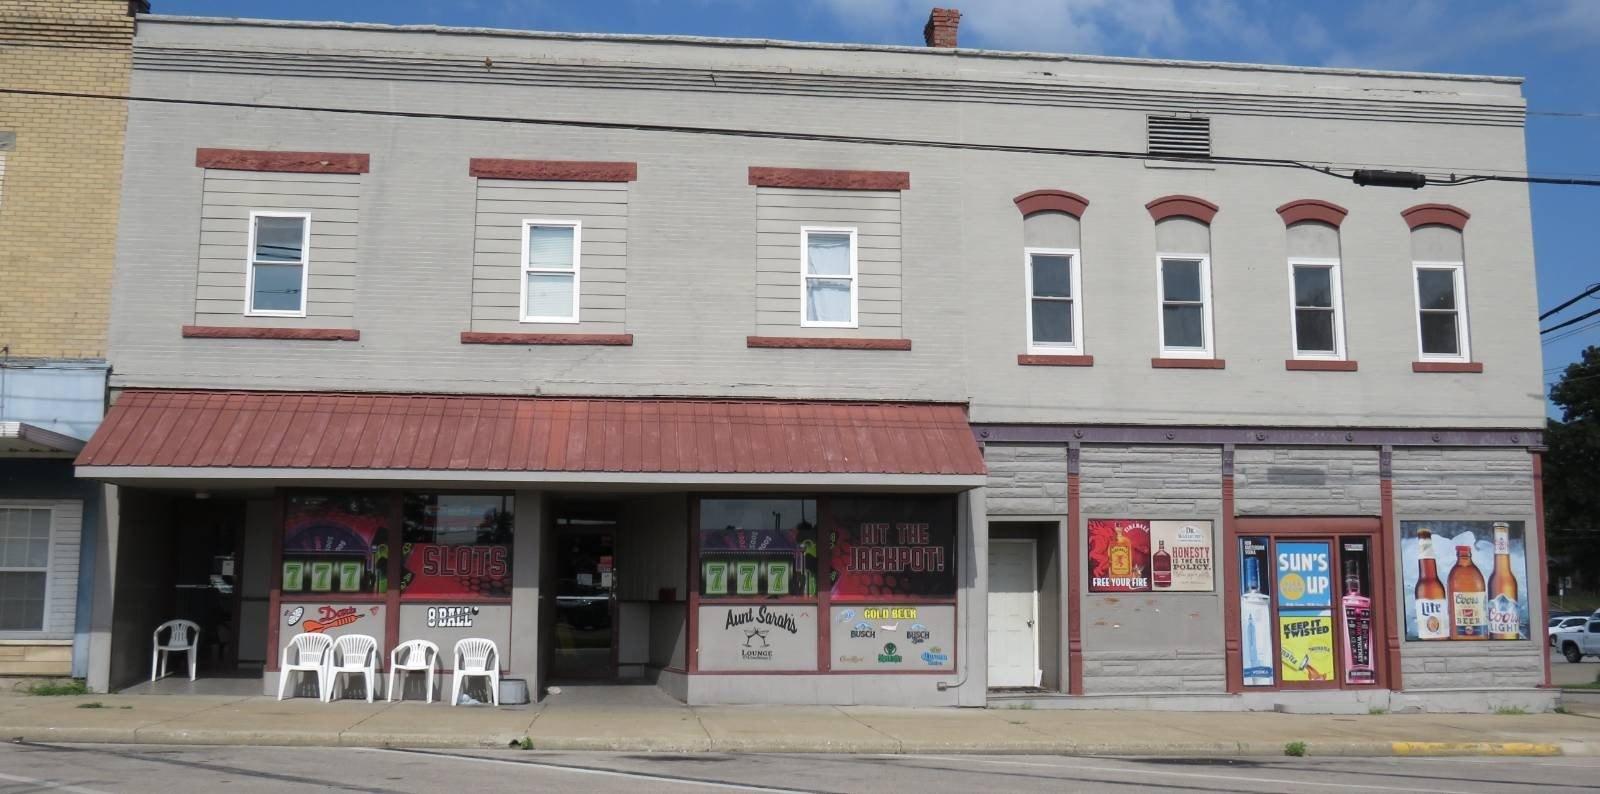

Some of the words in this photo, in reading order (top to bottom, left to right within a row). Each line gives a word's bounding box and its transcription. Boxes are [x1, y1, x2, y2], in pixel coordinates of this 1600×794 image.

[861, 523, 890, 544] HIT
[896, 523, 929, 544] THE
[847, 546, 945, 572] JACKPOT!
[1172, 547, 1210, 558] HONESTY
[423, 546, 507, 577] SLOTS
[1279, 553, 1328, 572] SUN'S
[1093, 578, 1110, 587] FREE
[1111, 578, 1131, 587] YOUR
[1132, 578, 1148, 587] FIRE
[1306, 576, 1329, 595] UP
[1421, 602, 1441, 616] Lite
[427, 607, 436, 627] 8
[438, 607, 473, 627] BALL
[725, 608, 754, 630] Aunt
[756, 605, 798, 634] Sarah's
[1456, 617, 1480, 625] BEER
[1283, 620, 1310, 632] KEEP
[1311, 619, 1321, 629] IT
[1284, 625, 1330, 639] TWISTED
[850, 630, 876, 639] BUSCH
[906, 631, 930, 640] BUSCH
